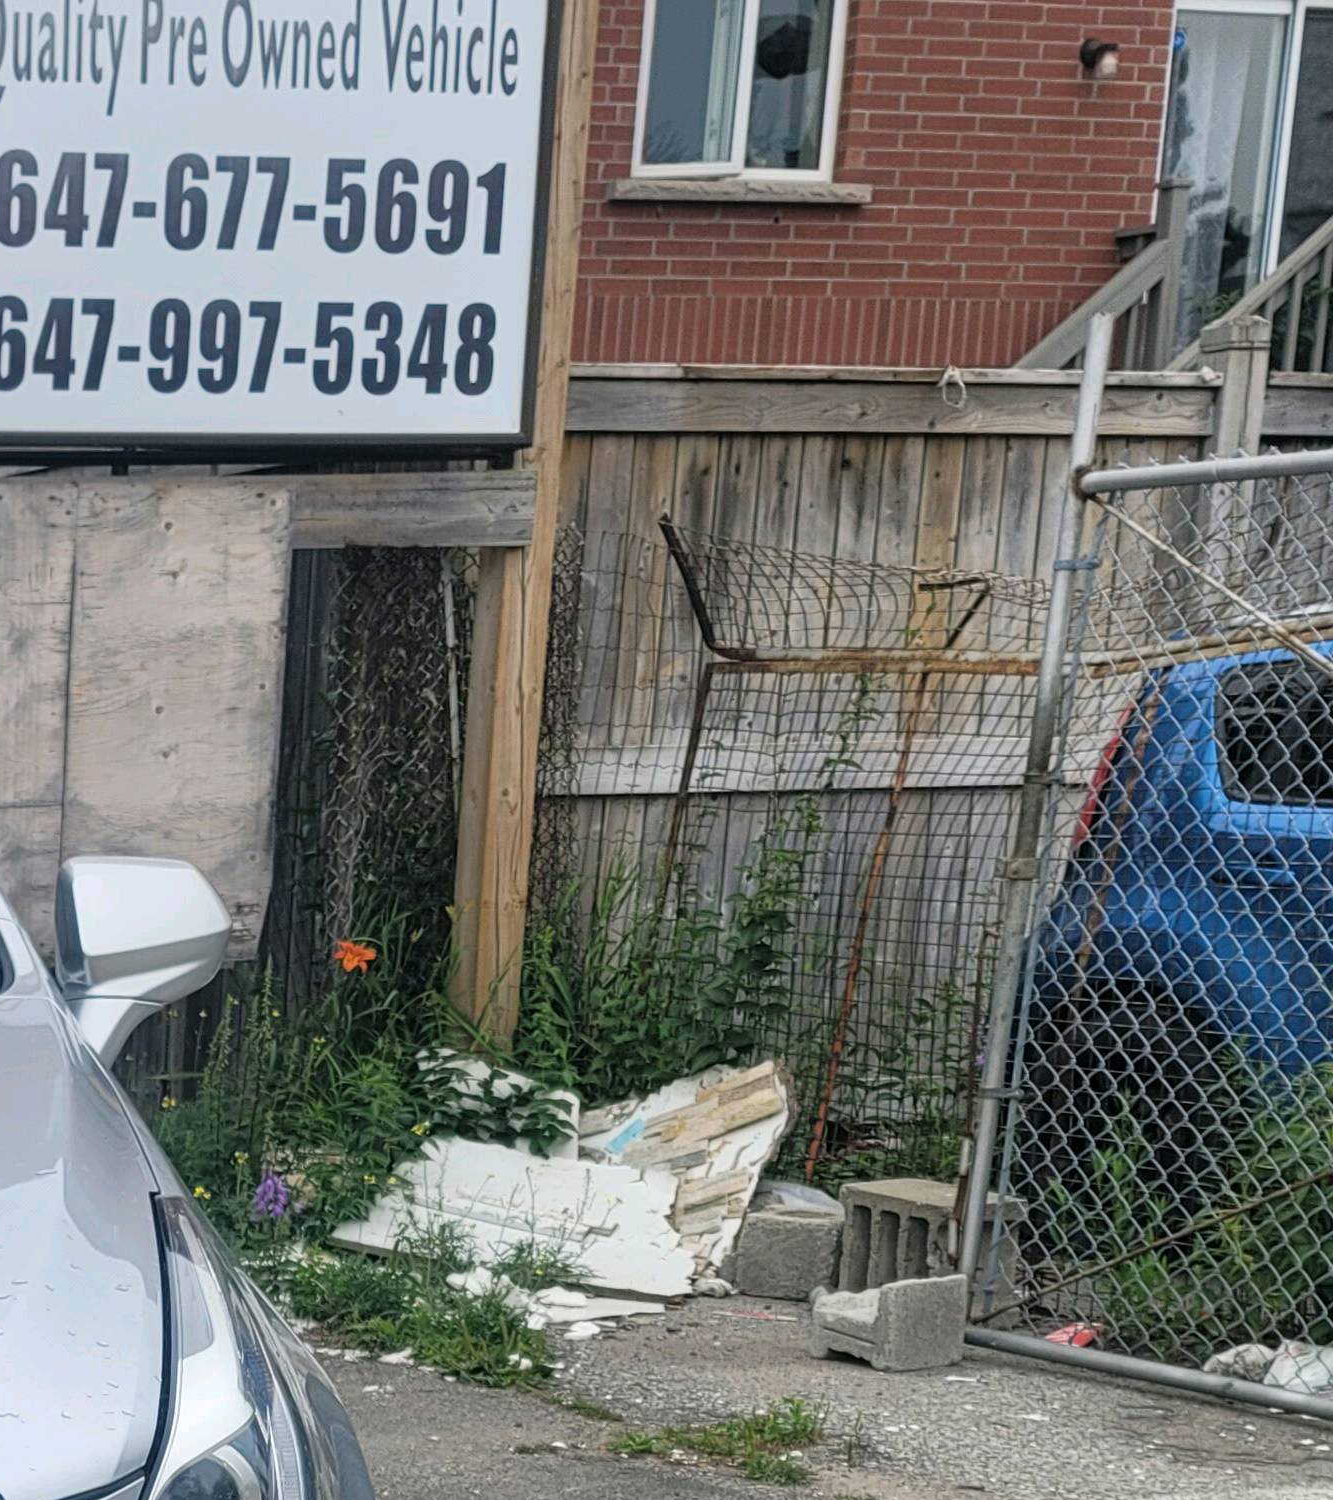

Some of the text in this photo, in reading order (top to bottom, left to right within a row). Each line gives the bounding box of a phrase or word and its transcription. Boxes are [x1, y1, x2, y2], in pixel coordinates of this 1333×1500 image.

[139, 0, 208, 89] Pre
[221, 0, 362, 92] Owned
[382, 0, 520, 97] Vehicle
